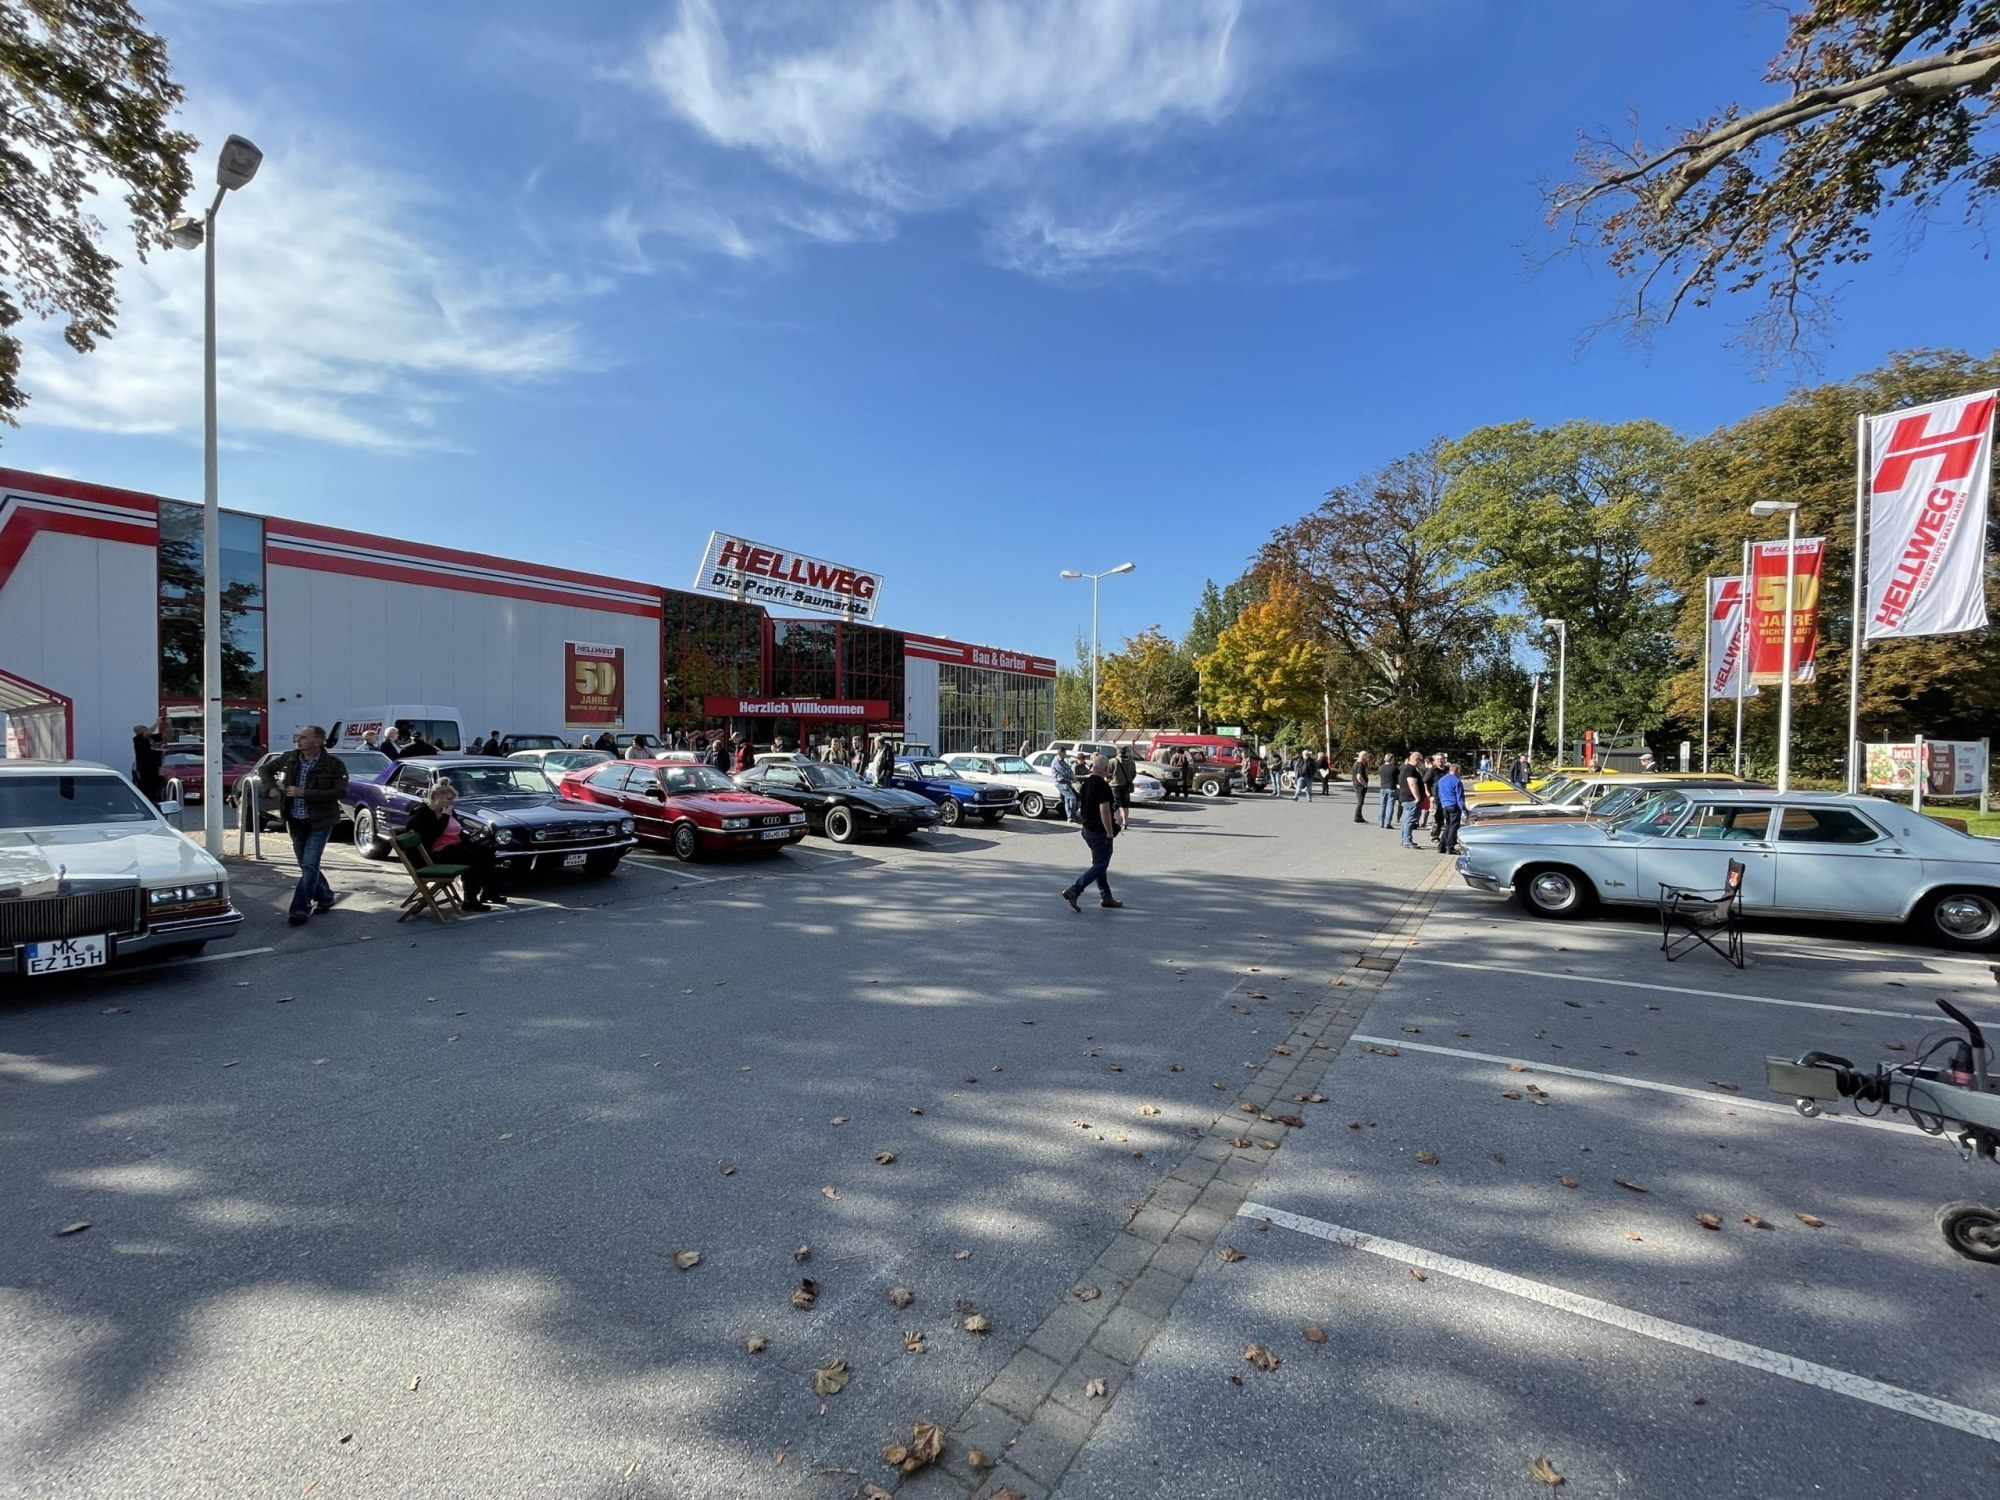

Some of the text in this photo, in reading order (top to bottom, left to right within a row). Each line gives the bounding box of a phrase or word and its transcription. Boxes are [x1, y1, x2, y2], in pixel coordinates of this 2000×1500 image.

[1875, 488, 1957, 628] HELLWEG
[1920, 565, 1936, 590] IDEEN
[1931, 541, 1947, 564] MUSS
[1942, 522, 1955, 540] MAN
[718, 540, 875, 599] HELLWEG
[711, 572, 869, 615] Die Profi-Baumärkte
[1756, 574, 1819, 611] 50
[1759, 614, 1814, 627] JARE
[1796, 627, 1812, 635] GUT
[577, 645, 614, 655] HELLWEG
[972, 648, 1026, 670] Bau & Garten
[575, 660, 616, 695] 50
[580, 695, 608, 705] JAHRE
[739, 701, 864, 715] Herzlich Willkommen
[52, 940, 77, 956] MK
[31, 957, 57, 973] EZ
